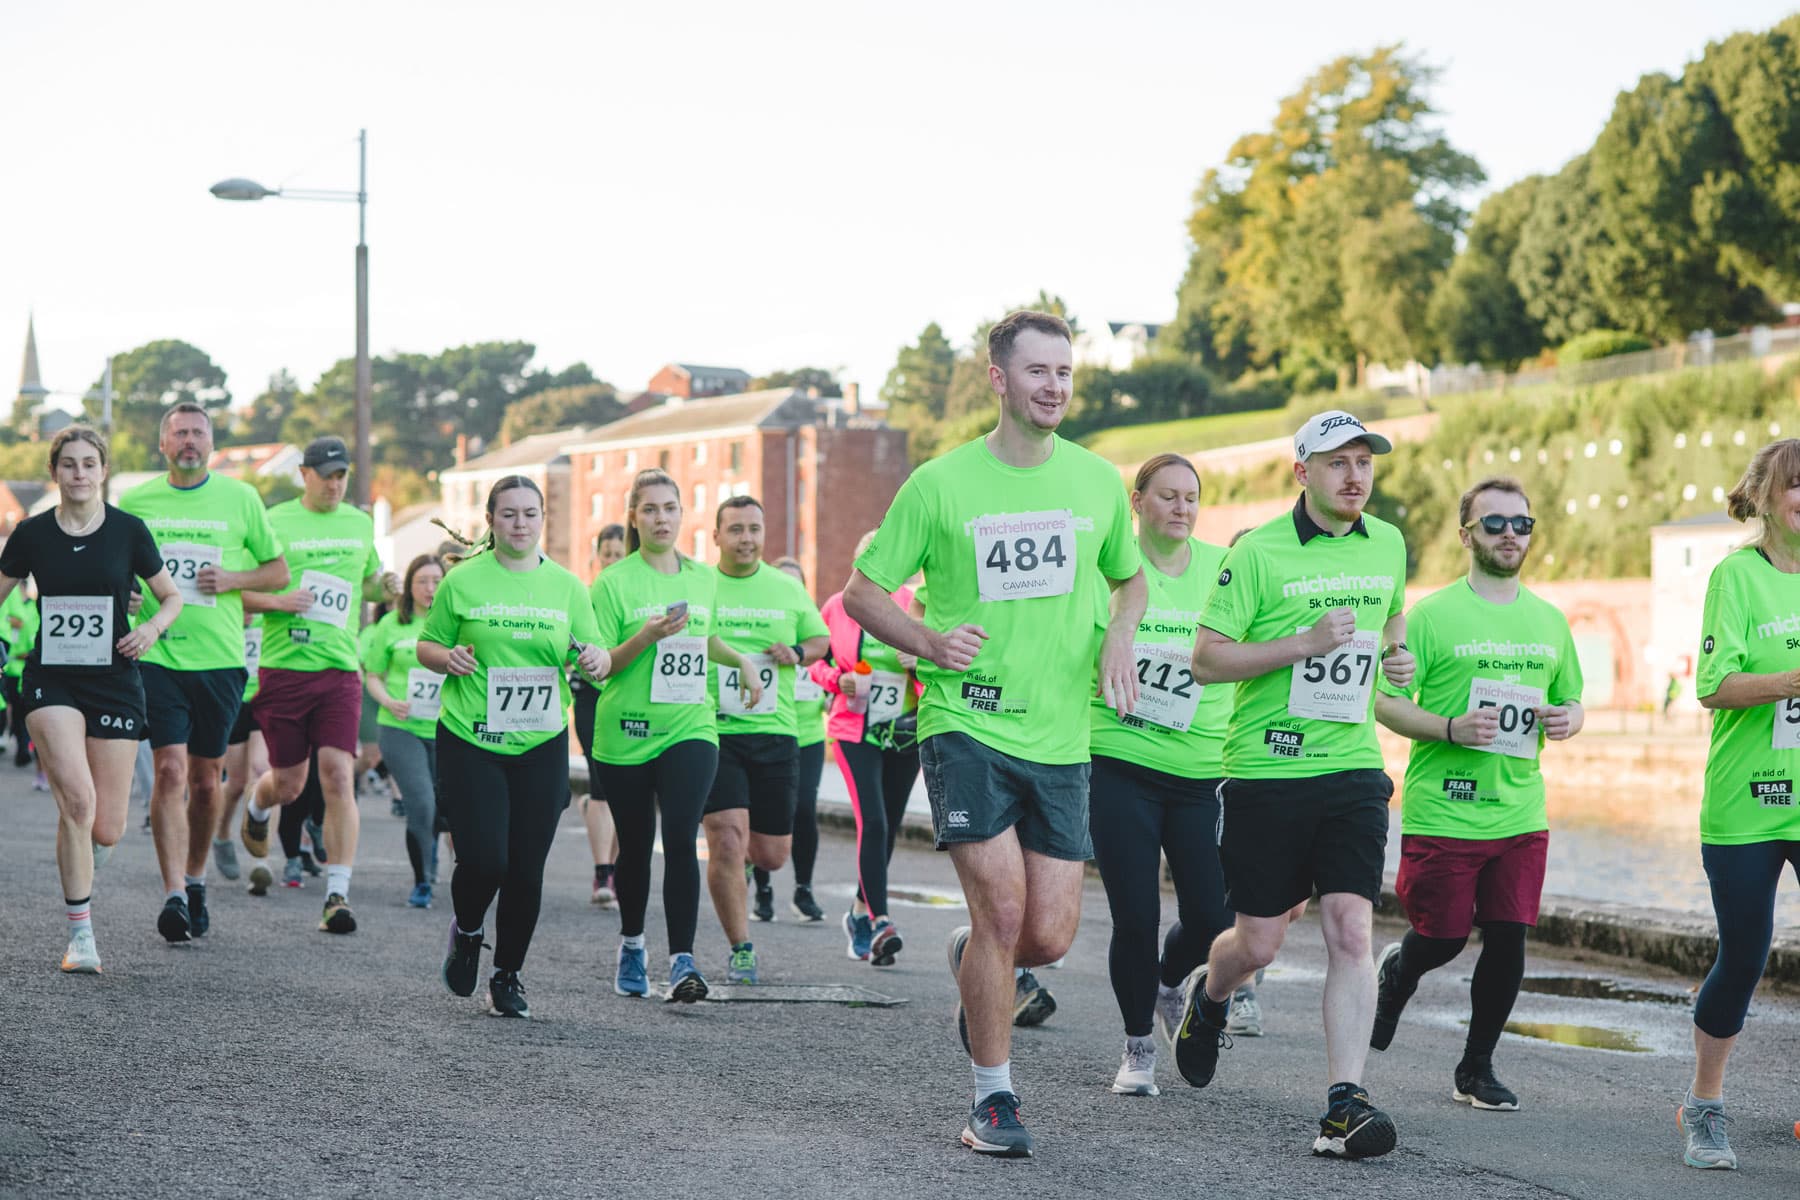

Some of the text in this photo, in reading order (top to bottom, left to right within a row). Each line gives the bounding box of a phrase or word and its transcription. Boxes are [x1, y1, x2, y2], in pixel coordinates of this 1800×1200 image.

[979, 520, 1066, 536] michelmores
[986, 535, 1066, 573] 484
[1002, 579, 1048, 591] CAVANNA
[1283, 573, 1394, 597] michelmores
[1309, 595, 1382, 608] 5k Charity Run
[49, 614, 104, 637] 293
[488, 619, 554, 630] 5k Charity Run
[1139, 624, 1192, 636] 5k Charity
[1786, 637, 1800, 650] 5k
[661, 653, 705, 676] 881
[1303, 653, 1372, 686] 567
[1478, 660, 1544, 672] 5k Charity Run
[726, 668, 773, 691] 49
[413, 682, 439, 699] 27
[871, 685, 898, 706] 73
[968, 686, 997, 699] FEAR
[1313, 691, 1356, 702] CAVANNA
[496, 686, 552, 711] 777
[971, 699, 998, 711] FREE
[1122, 716, 1144, 728] FREE
[481, 734, 502, 743] FREE
[1270, 731, 1298, 745] FEAR
[1273, 744, 1300, 757] FREE
[1762, 769, 1775, 777] aid
[1776, 768, 1785, 777] of
[1448, 780, 1472, 791] FEAR
[1757, 783, 1787, 793] FEAR
[1451, 791, 1475, 801] FREE
[1764, 795, 1791, 805] FREE
